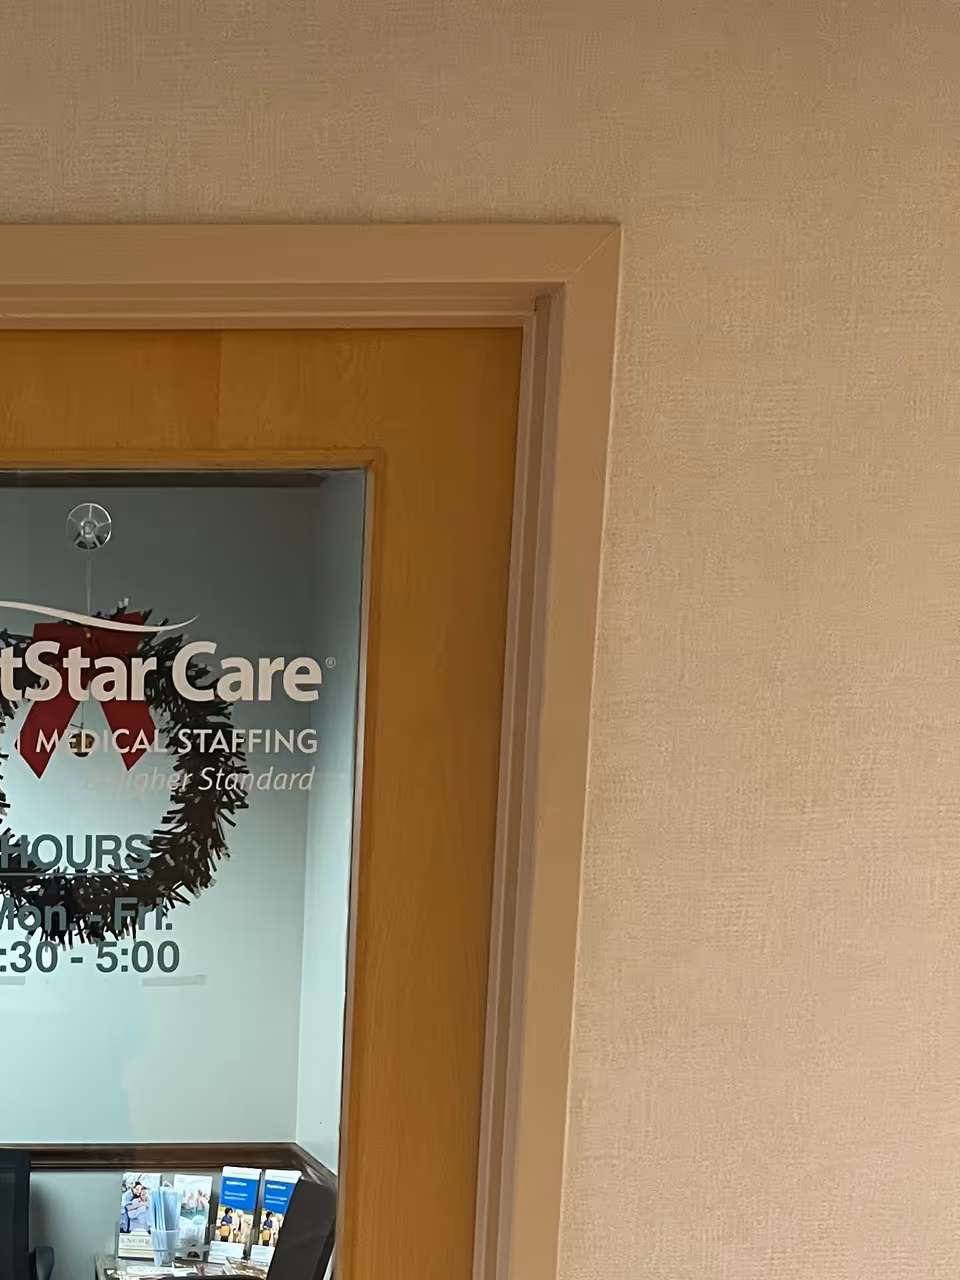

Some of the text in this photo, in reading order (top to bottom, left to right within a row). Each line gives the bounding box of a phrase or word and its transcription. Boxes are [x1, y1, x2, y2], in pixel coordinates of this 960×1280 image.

[172, 640, 322, 702] Care
[35, 728, 167, 753] MEDICAL
[178, 729, 318, 754] STAFFING
[198, 766, 316, 791] Standard
[0, 834, 151, 869] HOURS
[114, 897, 173, 931] Fri.
[96, 941, 180, 973] 5:00
